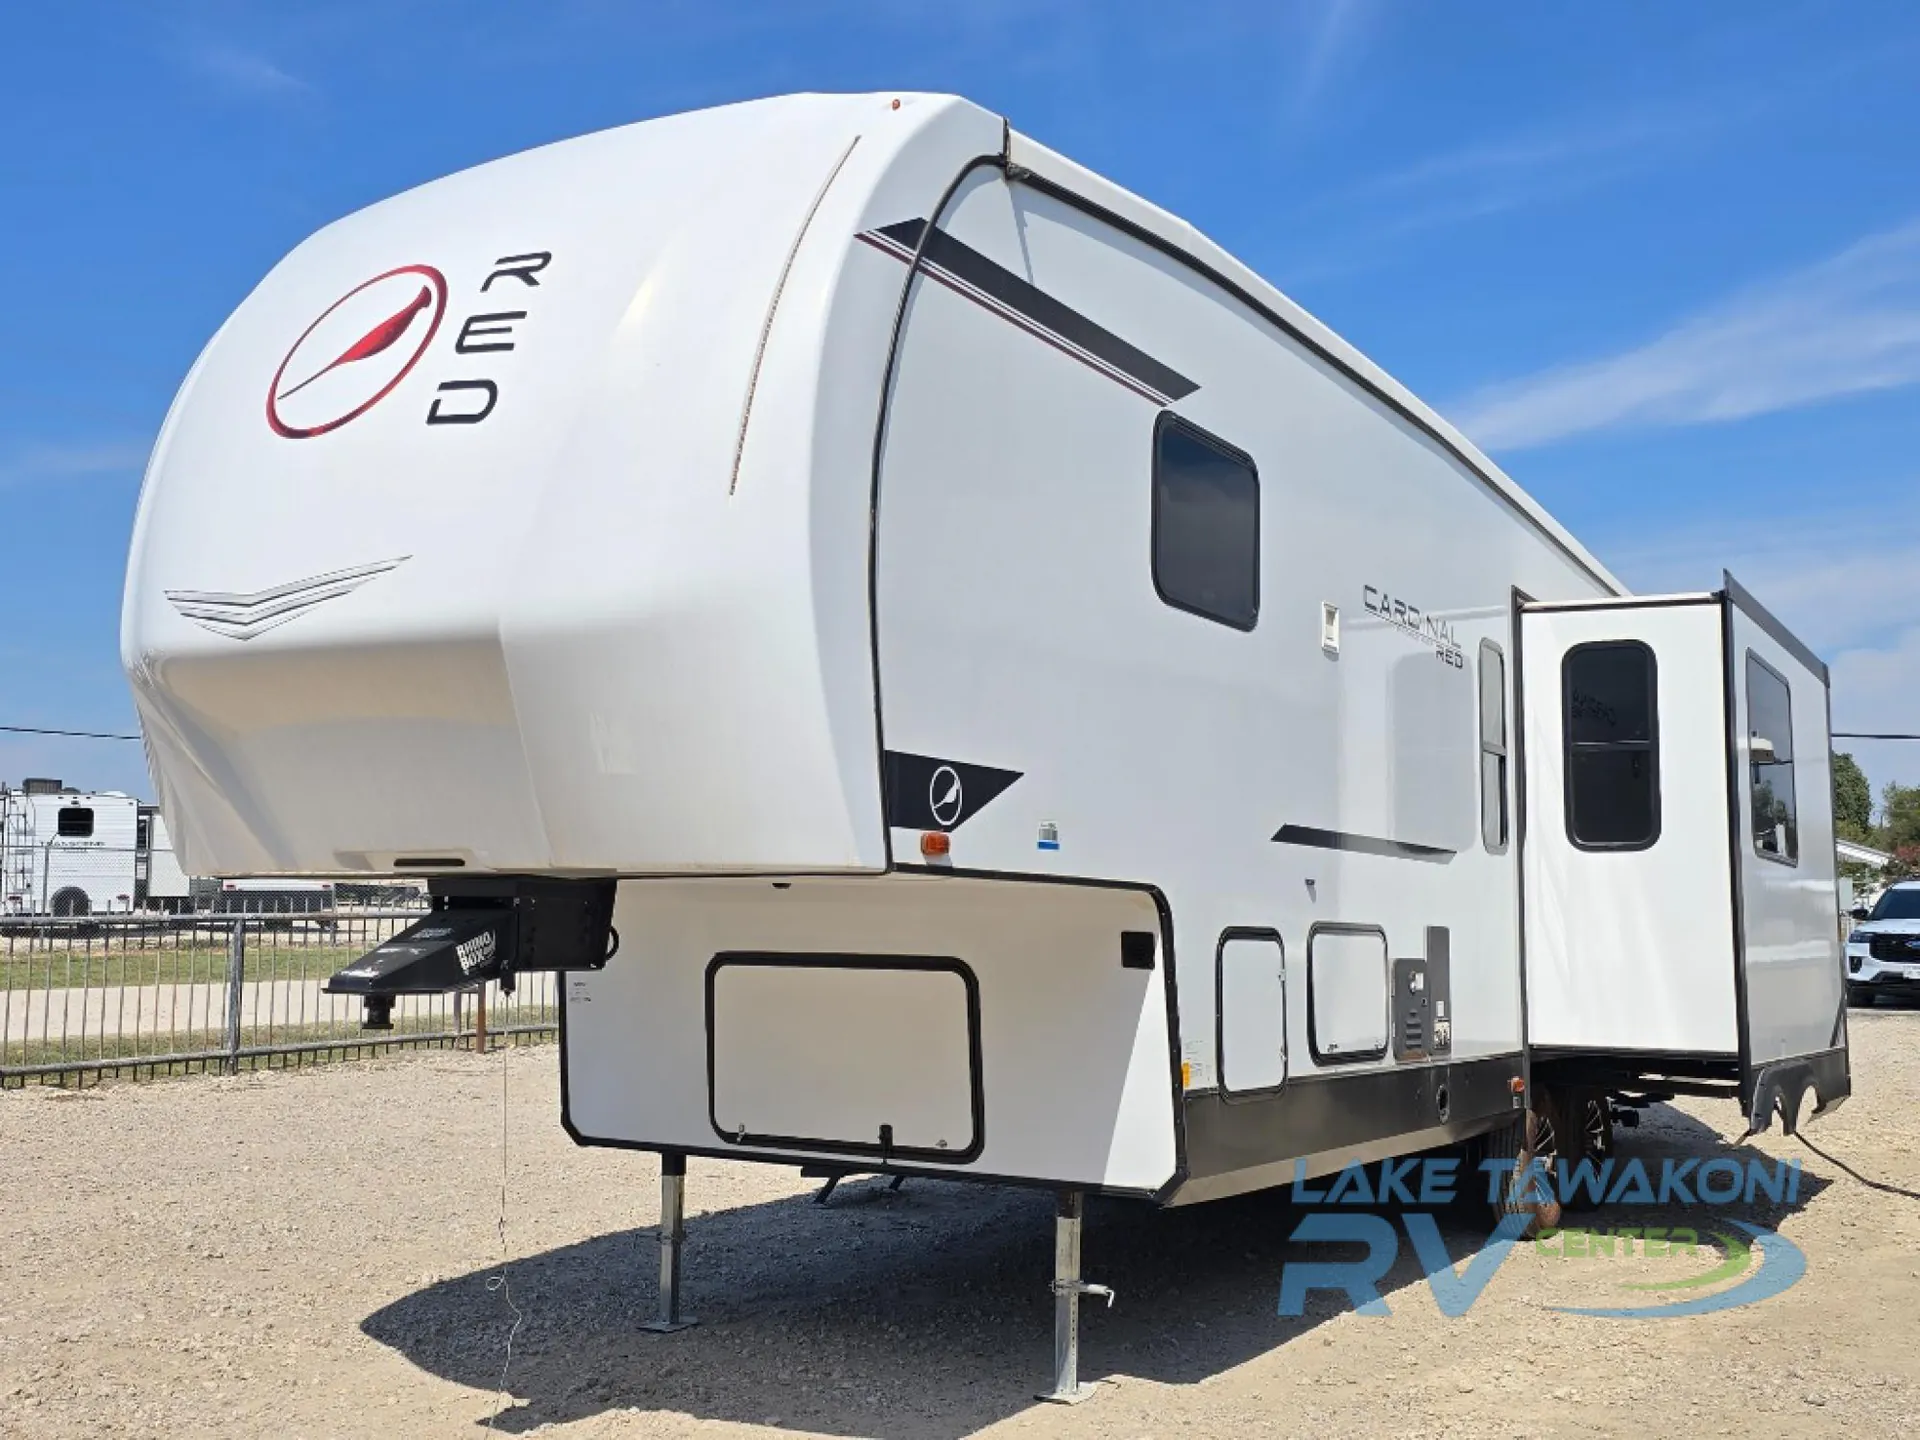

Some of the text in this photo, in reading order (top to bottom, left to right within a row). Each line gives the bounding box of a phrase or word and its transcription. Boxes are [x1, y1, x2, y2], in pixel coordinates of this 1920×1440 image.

[426, 251, 552, 425] RED
[1363, 585, 1462, 650] CARDINAL
[1436, 650, 1463, 669] RED
[455, 931, 490, 958] RHINO
[460, 947, 485, 970] BOX
